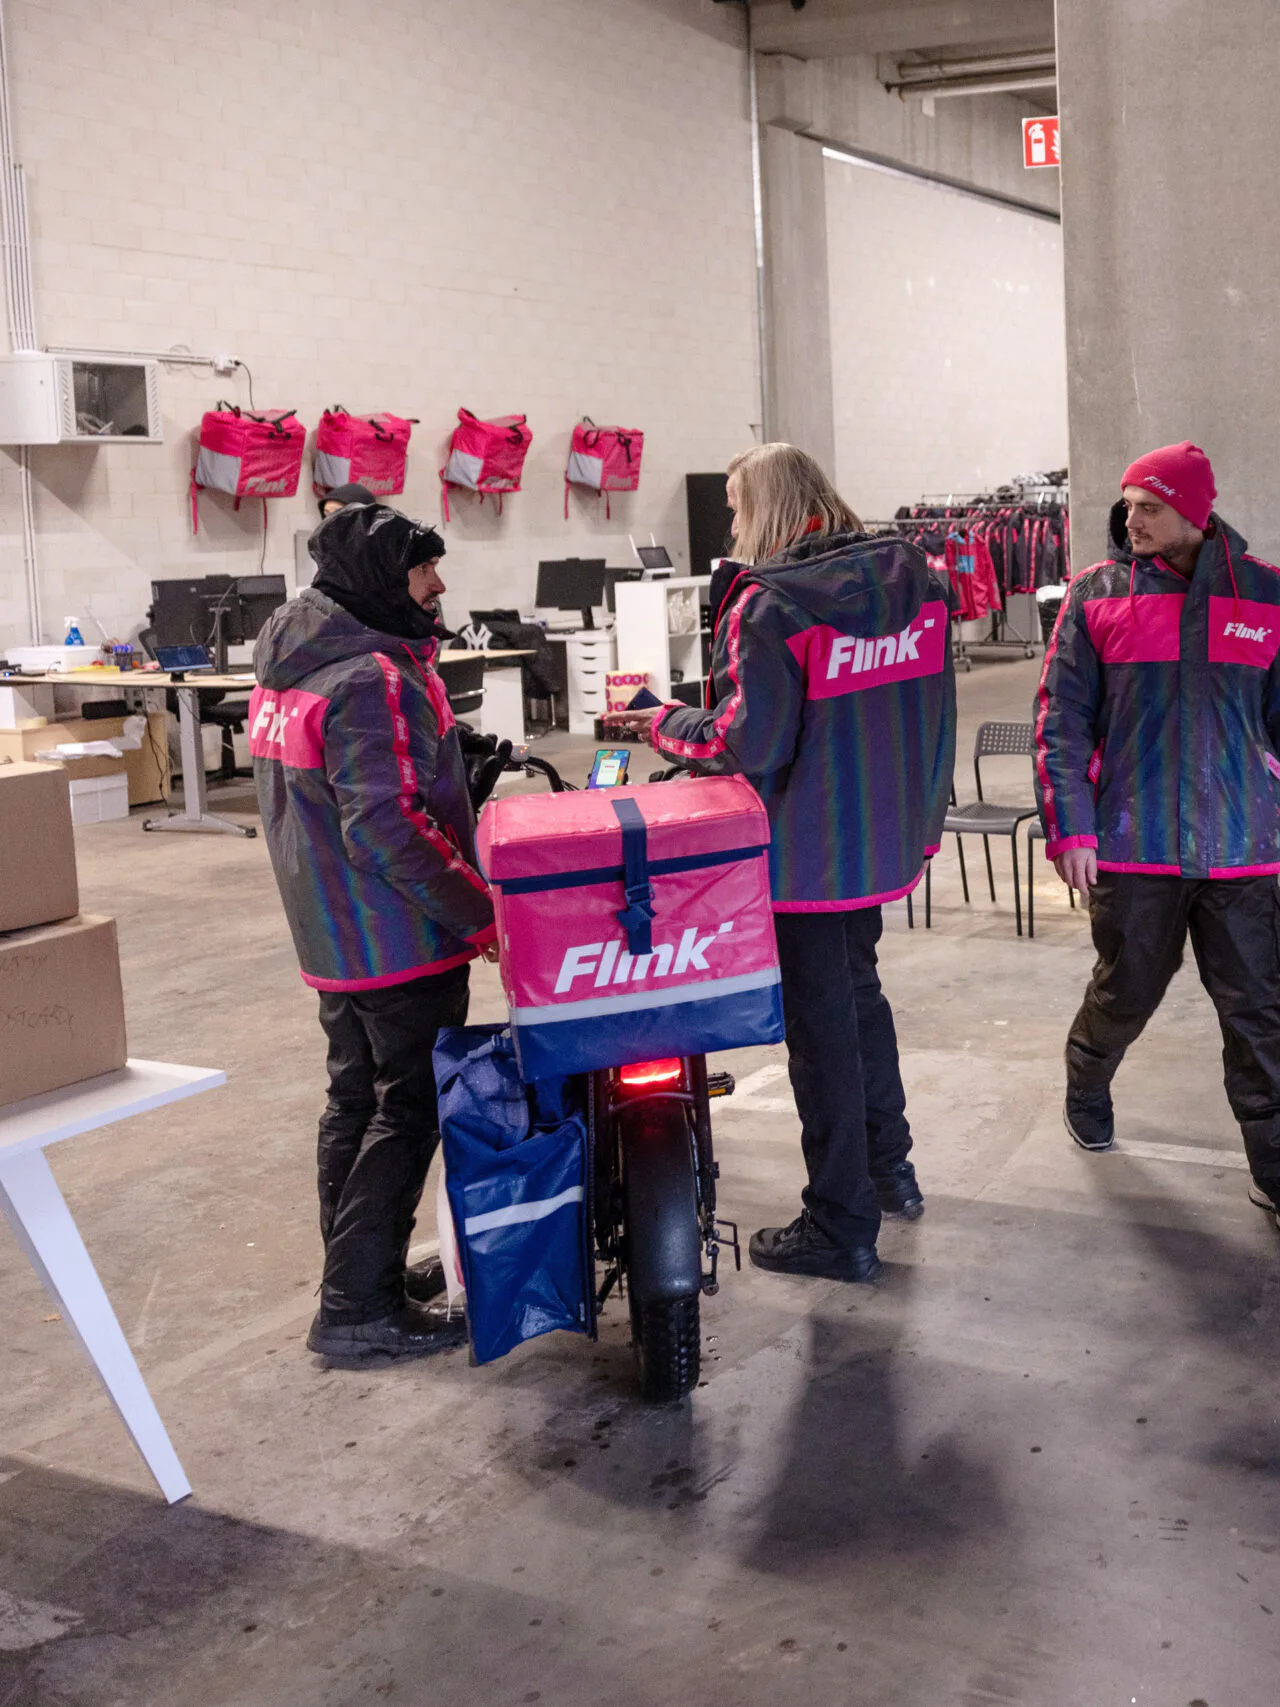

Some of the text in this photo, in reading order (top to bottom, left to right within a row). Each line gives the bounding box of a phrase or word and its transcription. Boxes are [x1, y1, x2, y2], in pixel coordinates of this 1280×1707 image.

[1144, 475, 1182, 497] Flink
[826, 619, 935, 680] Flink
[1223, 621, 1273, 643] Flink
[554, 921, 734, 994] Flink
